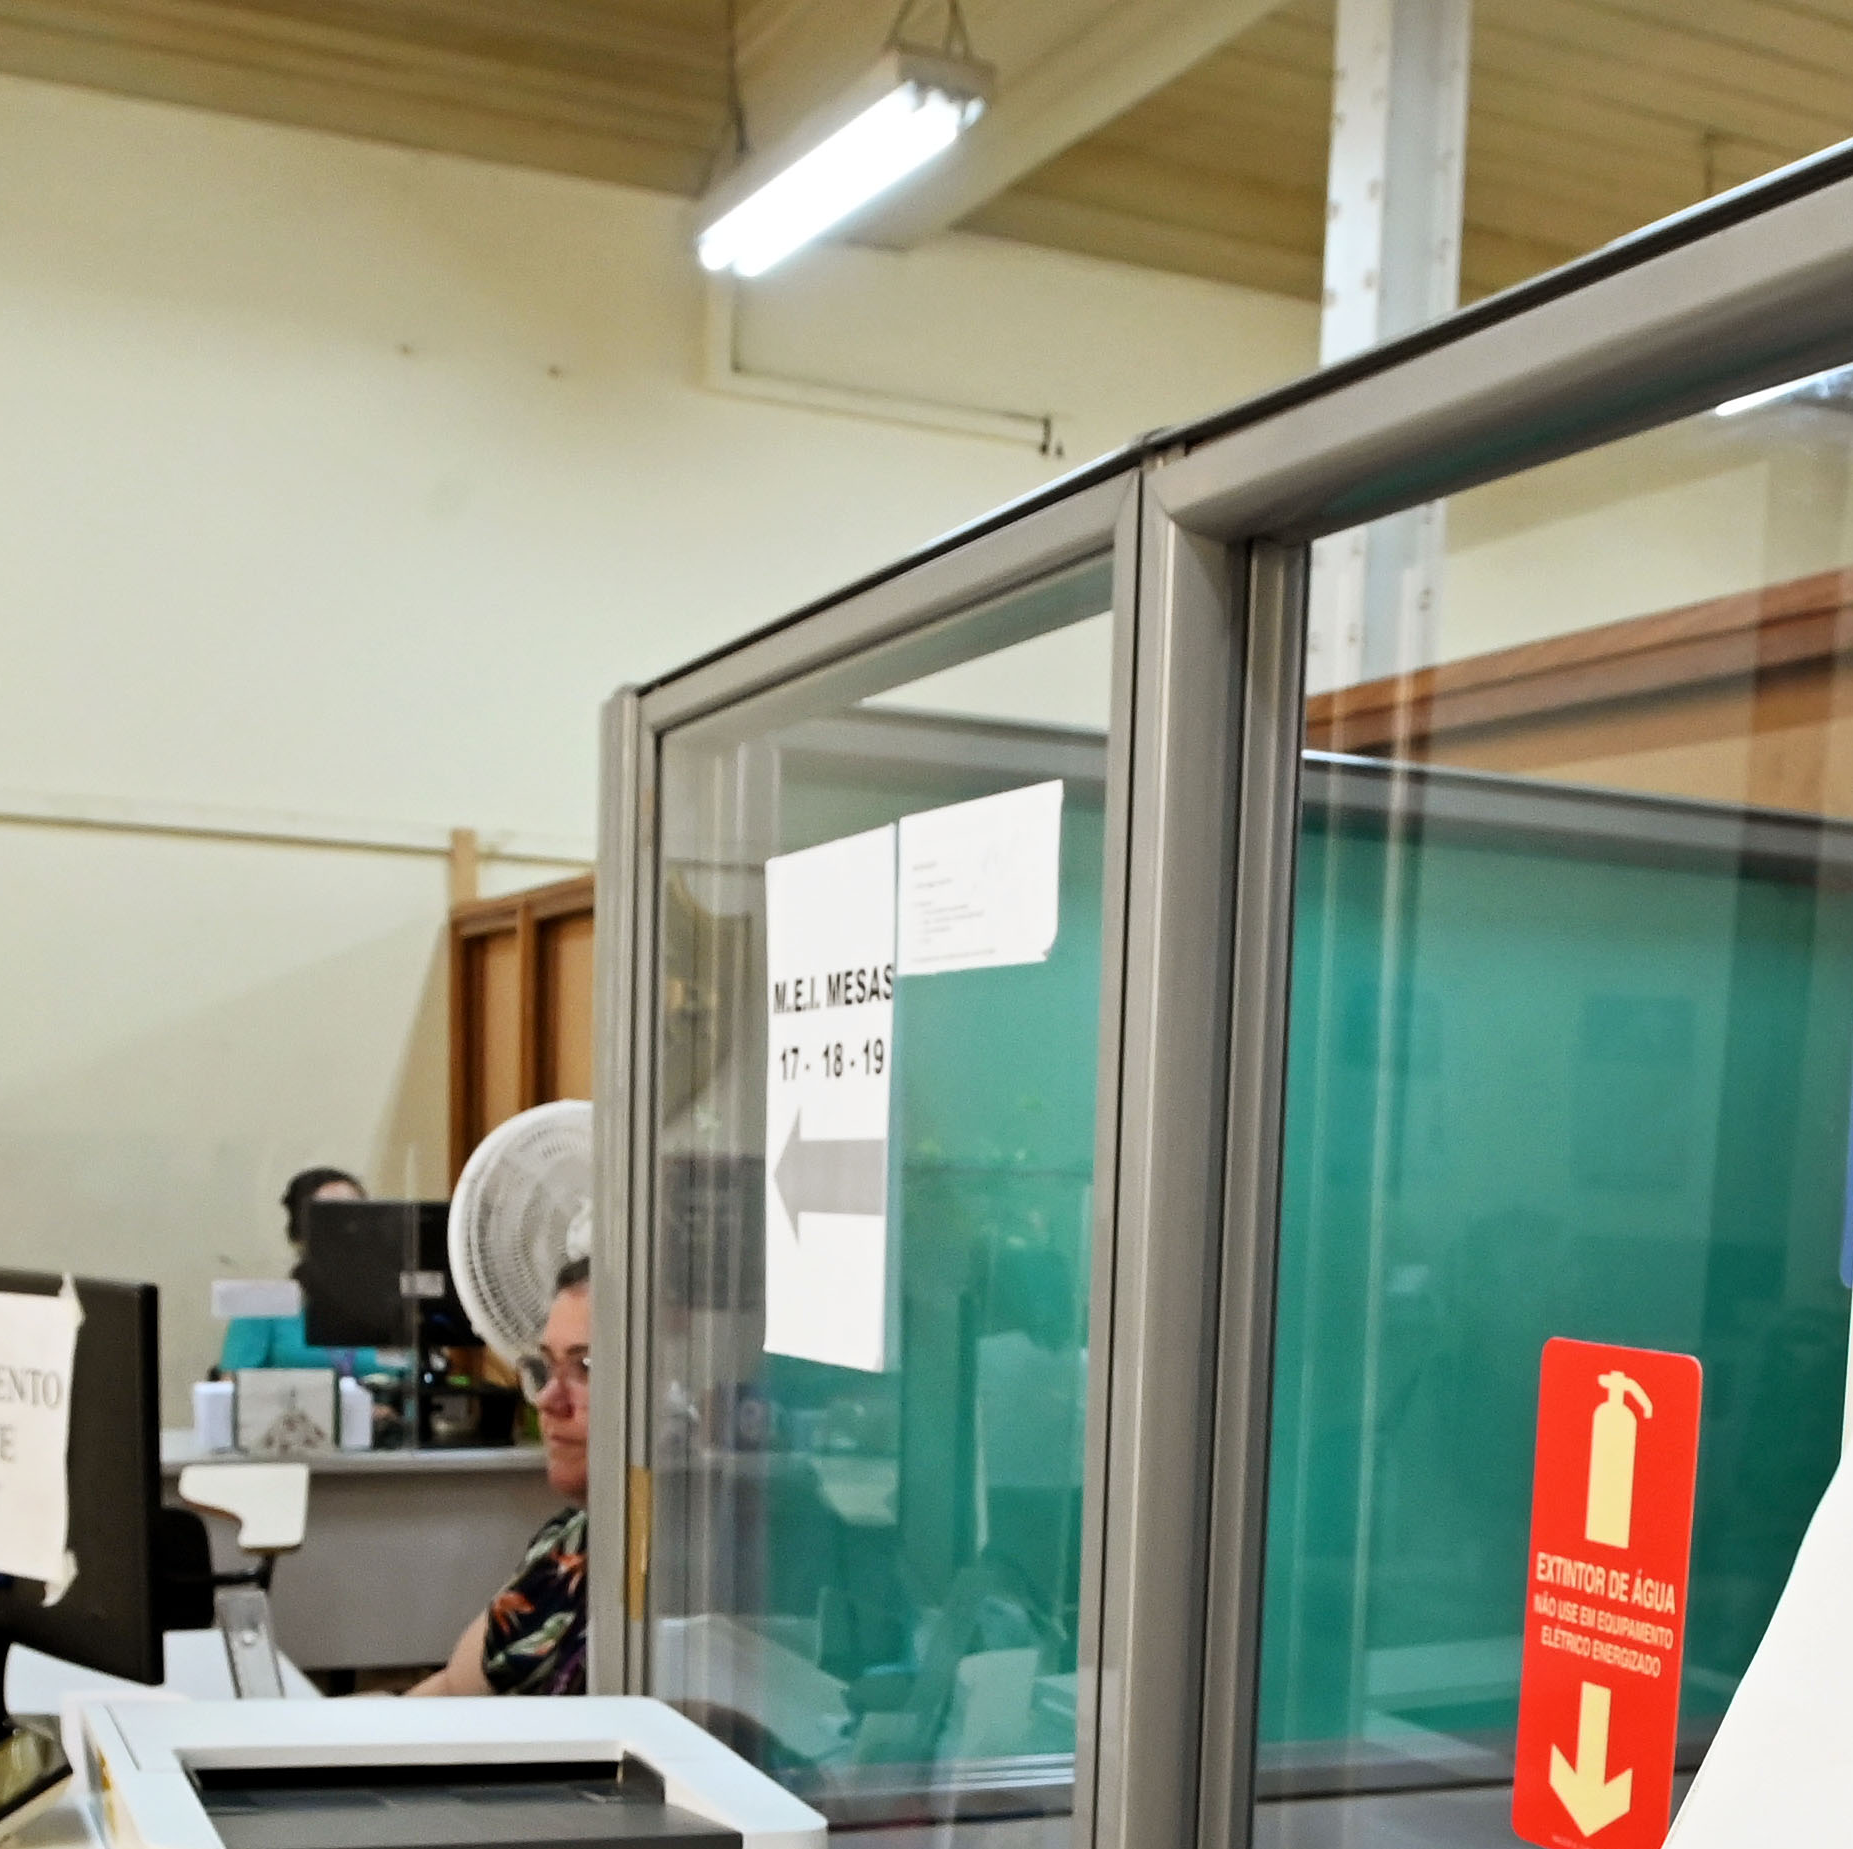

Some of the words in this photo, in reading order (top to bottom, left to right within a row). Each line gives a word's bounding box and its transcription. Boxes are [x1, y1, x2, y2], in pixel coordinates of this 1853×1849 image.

[773, 976, 821, 1014] M.E.I.
[826, 963, 894, 1008] MESAS
[781, 1046, 799, 1081] 17
[823, 1042, 843, 1078] 18
[863, 1038, 884, 1075] 19
[1536, 1551, 1606, 1596] EXTINTOR
[1608, 1569, 1630, 1603] DE
[1632, 1568, 1676, 1615] ÁGUA
[1533, 1590, 1557, 1618] NÃO
[1557, 1599, 1579, 1624] USE
[1579, 1605, 1597, 1628] EM
[1597, 1610, 1674, 1650] EQUIPAMENTO
[1540, 1623, 1591, 1658] ELÉTRICO
[1592, 1639, 1661, 1679] ENERGIZADO
